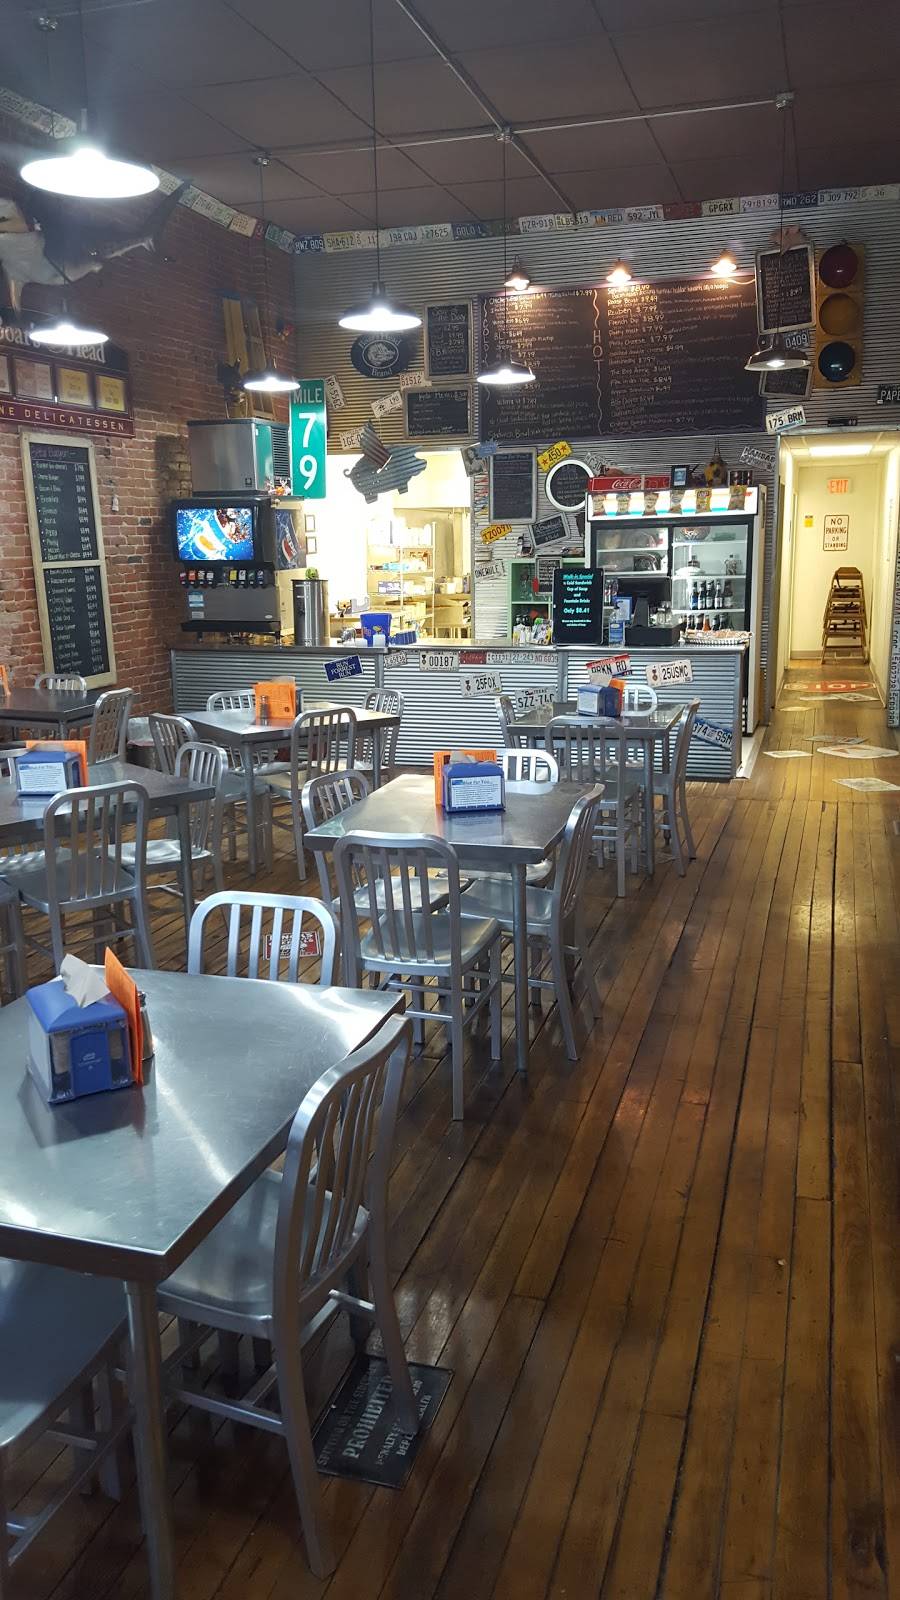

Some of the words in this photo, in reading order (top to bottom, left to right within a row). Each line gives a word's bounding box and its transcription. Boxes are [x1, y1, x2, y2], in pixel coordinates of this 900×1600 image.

[785, 332, 808, 349] 0409
[592, 330, 606, 371] HOT
[293, 387, 323, 404] MILE
[24, 409, 125, 432] DELICATESSEN
[787, 408, 804, 423] BRM
[299, 412, 317, 449] 7
[548, 447, 562, 462] 450
[299, 454, 318, 491] 9
[830, 479, 849, 494] EXIT
[831, 518, 843, 526] NO
[825, 526, 847, 535] PARKING
[563, 607, 575, 615] Only
[429, 655, 454, 668] 00187
[338, 669, 352, 678] RUN
[662, 664, 689, 681] 25USMC
[475, 676, 498, 691] 25FOX
[342, 1374, 393, 1459] PROHIBITED
